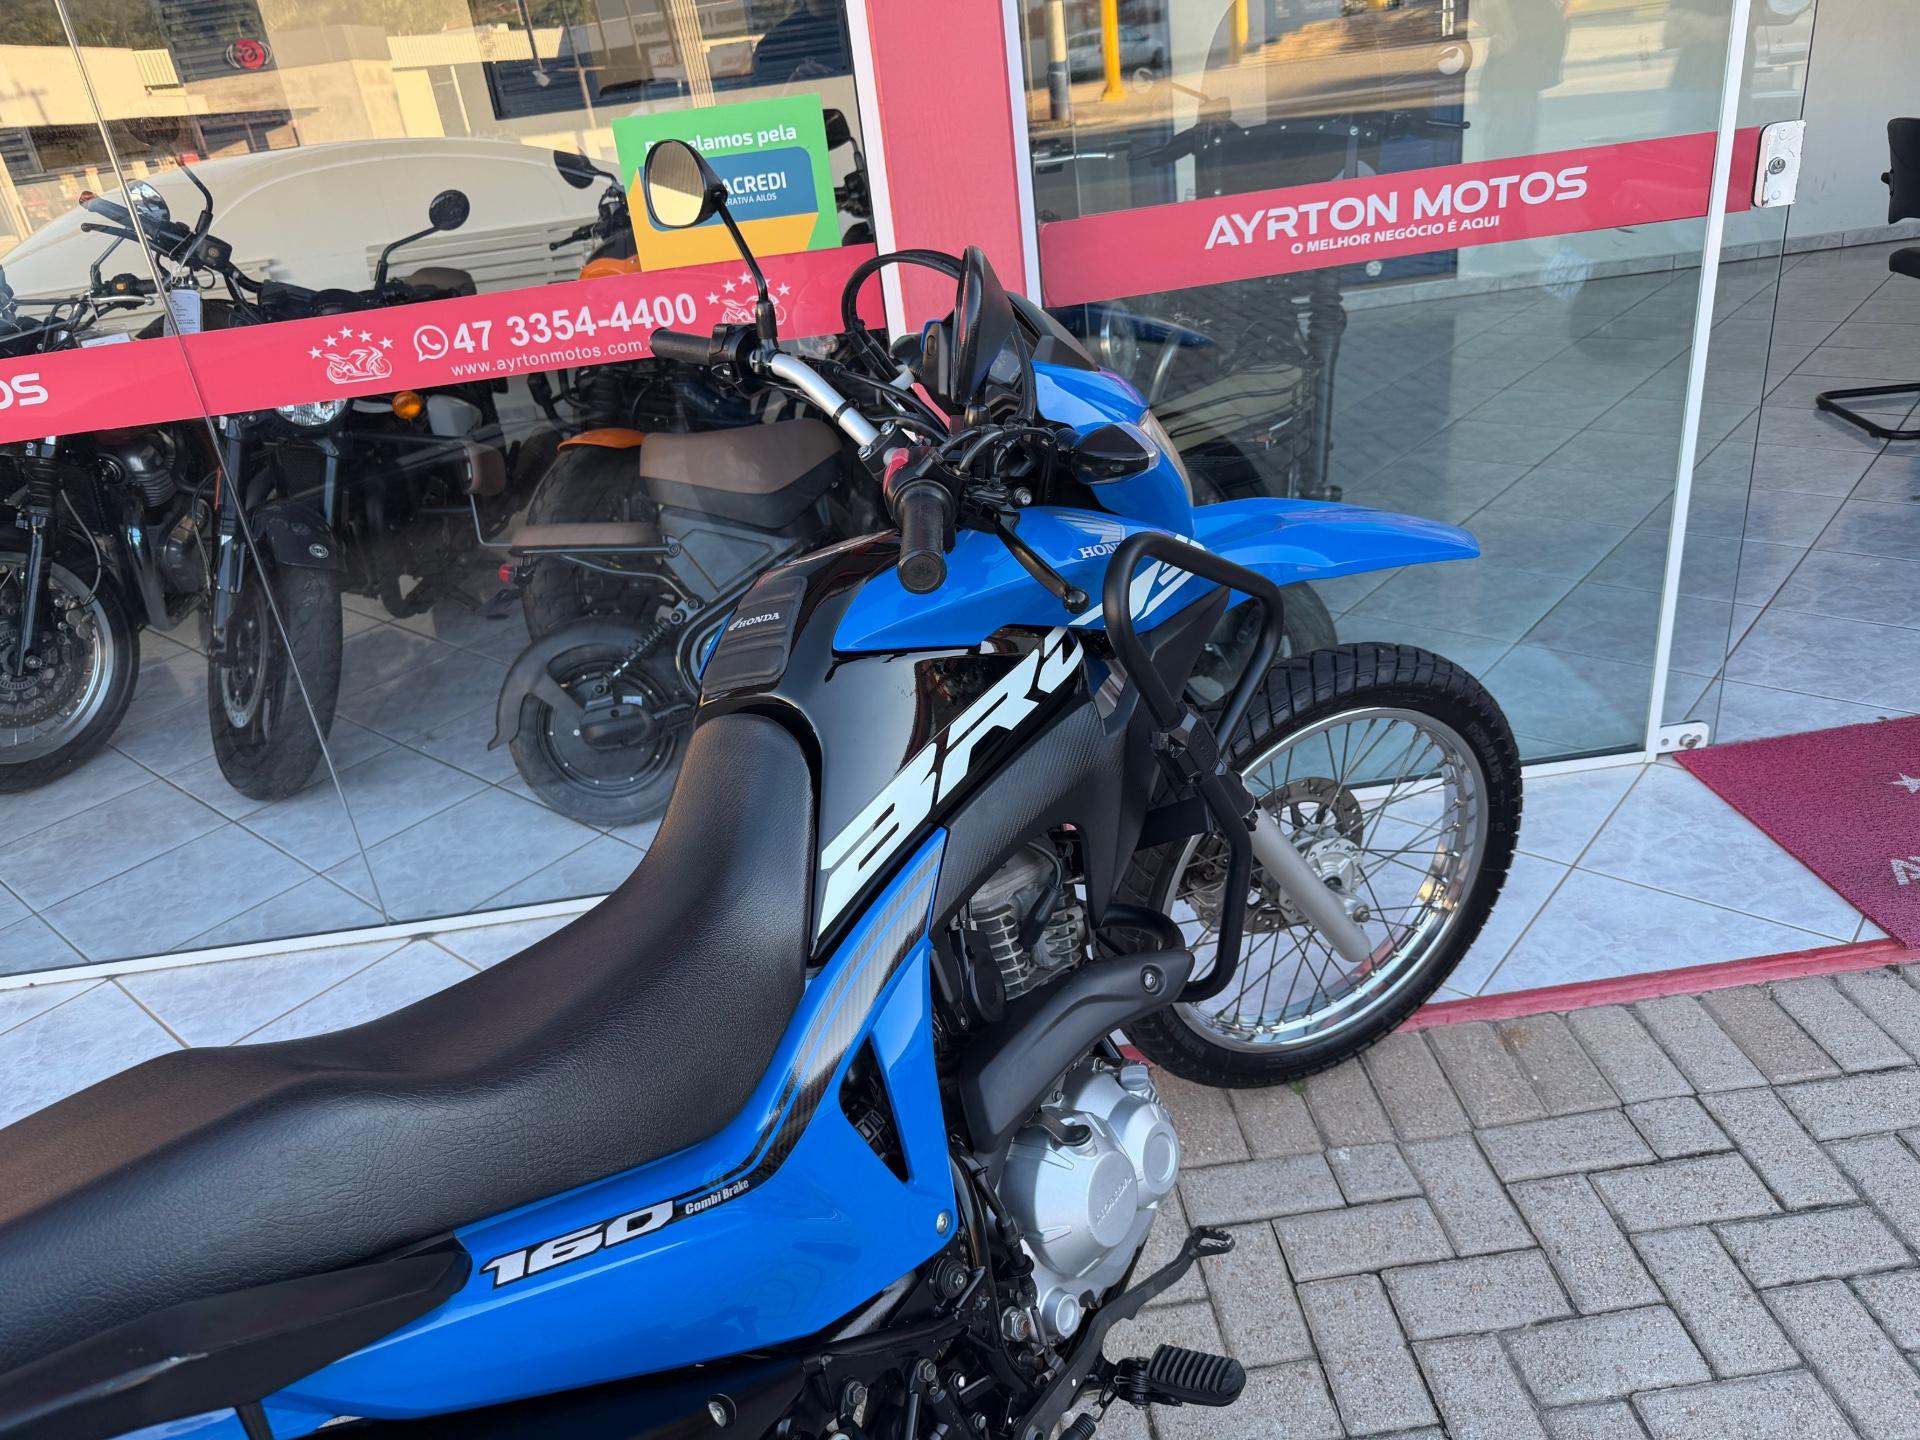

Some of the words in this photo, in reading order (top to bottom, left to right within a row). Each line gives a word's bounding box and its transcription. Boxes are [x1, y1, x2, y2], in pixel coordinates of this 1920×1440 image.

[757, 124, 797, 147] pela
[722, 171, 787, 195] ACREDI
[725, 195, 755, 207] RATIVA
[755, 192, 777, 203] AILOS
[1204, 191, 1398, 250] AYRTON
[1413, 165, 1588, 220] MOTOS
[1290, 242, 1304, 255] O
[1306, 233, 1371, 253] MELHOR
[1374, 224, 1445, 243] NEGÓCIO
[1447, 218, 1458, 233] É
[1459, 215, 1500, 232] AQUI
[453, 320, 493, 354] 47
[506, 293, 697, 347] 3354-4400
[450, 339, 650, 377] www.ayrtonmotos.com.
[1078, 541, 1121, 559] HON
[737, 612, 781, 629] HONDA
[684, 1191, 722, 1215] Combi
[722, 1179, 750, 1200] Brake
[480, 1199, 674, 1286] 160
